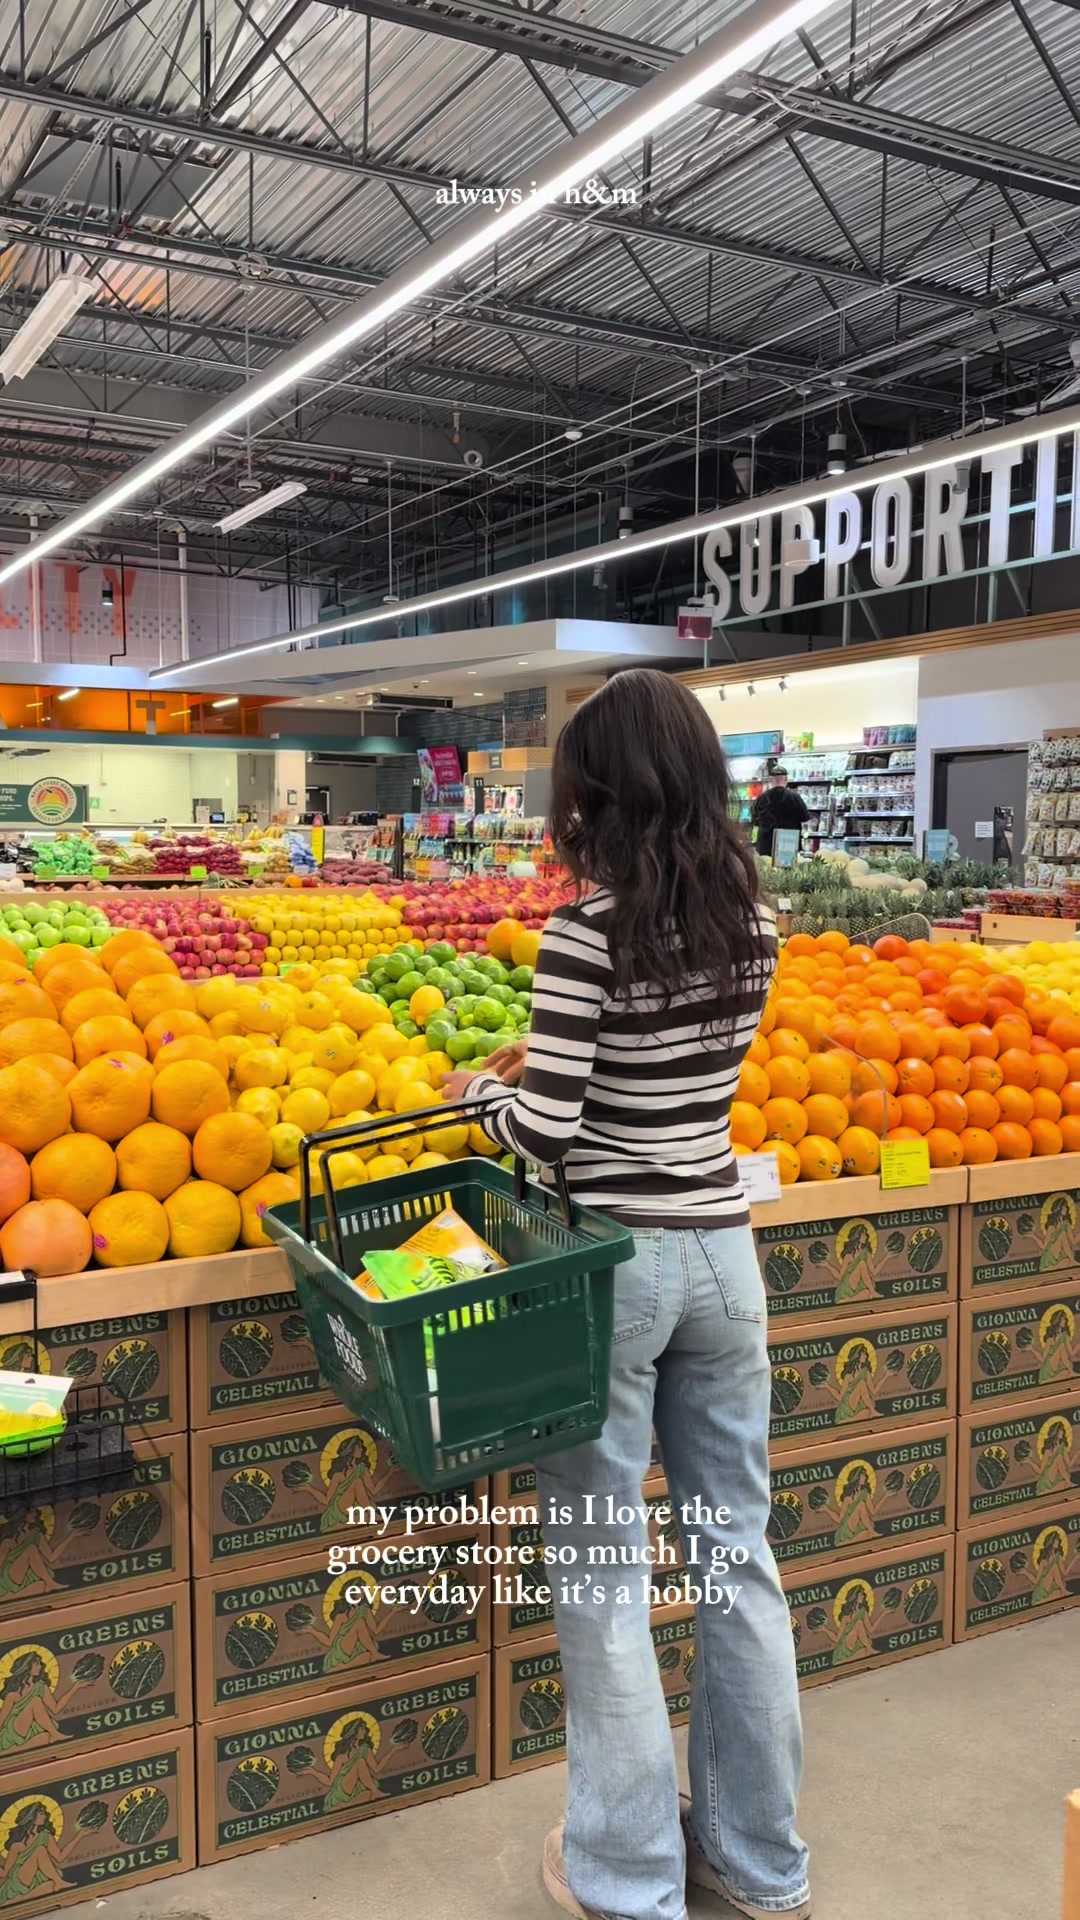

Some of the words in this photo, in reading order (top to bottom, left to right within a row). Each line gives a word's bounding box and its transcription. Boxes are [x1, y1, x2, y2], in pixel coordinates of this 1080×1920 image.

[764, 1221, 834, 1240] GIONNA
[878, 1208, 944, 1226] GREENS
[976, 1262, 1037, 1280] CELESTIAL
[892, 1277, 942, 1294] SOILS
[218, 1293, 299, 1317] GIONN
[977, 1308, 1038, 1328] GIONNA
[51, 1313, 160, 1344] GREENS
[878, 1324, 943, 1346] GREENS
[216, 1376, 314, 1404] CELESTIAL
[976, 1375, 1036, 1396] CELESTIAL
[892, 1393, 941, 1412] SOILS
[975, 1421, 1036, 1443] GIONNA
[219, 1435, 318, 1466] GIONNA
[876, 1443, 942, 1467] GREENS
[973, 1487, 1033, 1510] CELESTIAL
[218, 1520, 316, 1552] CELESTIAL
[774, 1536, 831, 1560] ELESTIAL
[891, 1511, 940, 1532] SOILS
[972, 1532, 1032, 1556] GIONNA
[82, 1552, 162, 1582] SOILS
[223, 1579, 320, 1610] GIONNA
[786, 1586, 832, 1606] ONNA
[875, 1558, 940, 1585] GREENS
[970, 1596, 1029, 1623] CELESTIAL
[58, 1614, 166, 1650] GREENS
[402, 1625, 468, 1652] SOILS
[652, 1621, 696, 1643] GREE
[888, 1626, 938, 1648] SOILS
[518, 1658, 562, 1678] GIO
[796, 1656, 830, 1674] STIAL
[222, 1662, 318, 1696] CELESTIAL
[86, 1700, 166, 1732] SOILS
[224, 1722, 322, 1756] GIONNA
[381, 1683, 470, 1718] GREENS
[516, 1731, 566, 1754] CELES
[64, 1759, 169, 1800] GREENS
[224, 1803, 319, 1839] CELESTIAL
[402, 1761, 468, 1790] SOILS
[90, 1844, 169, 1879] SOILS
